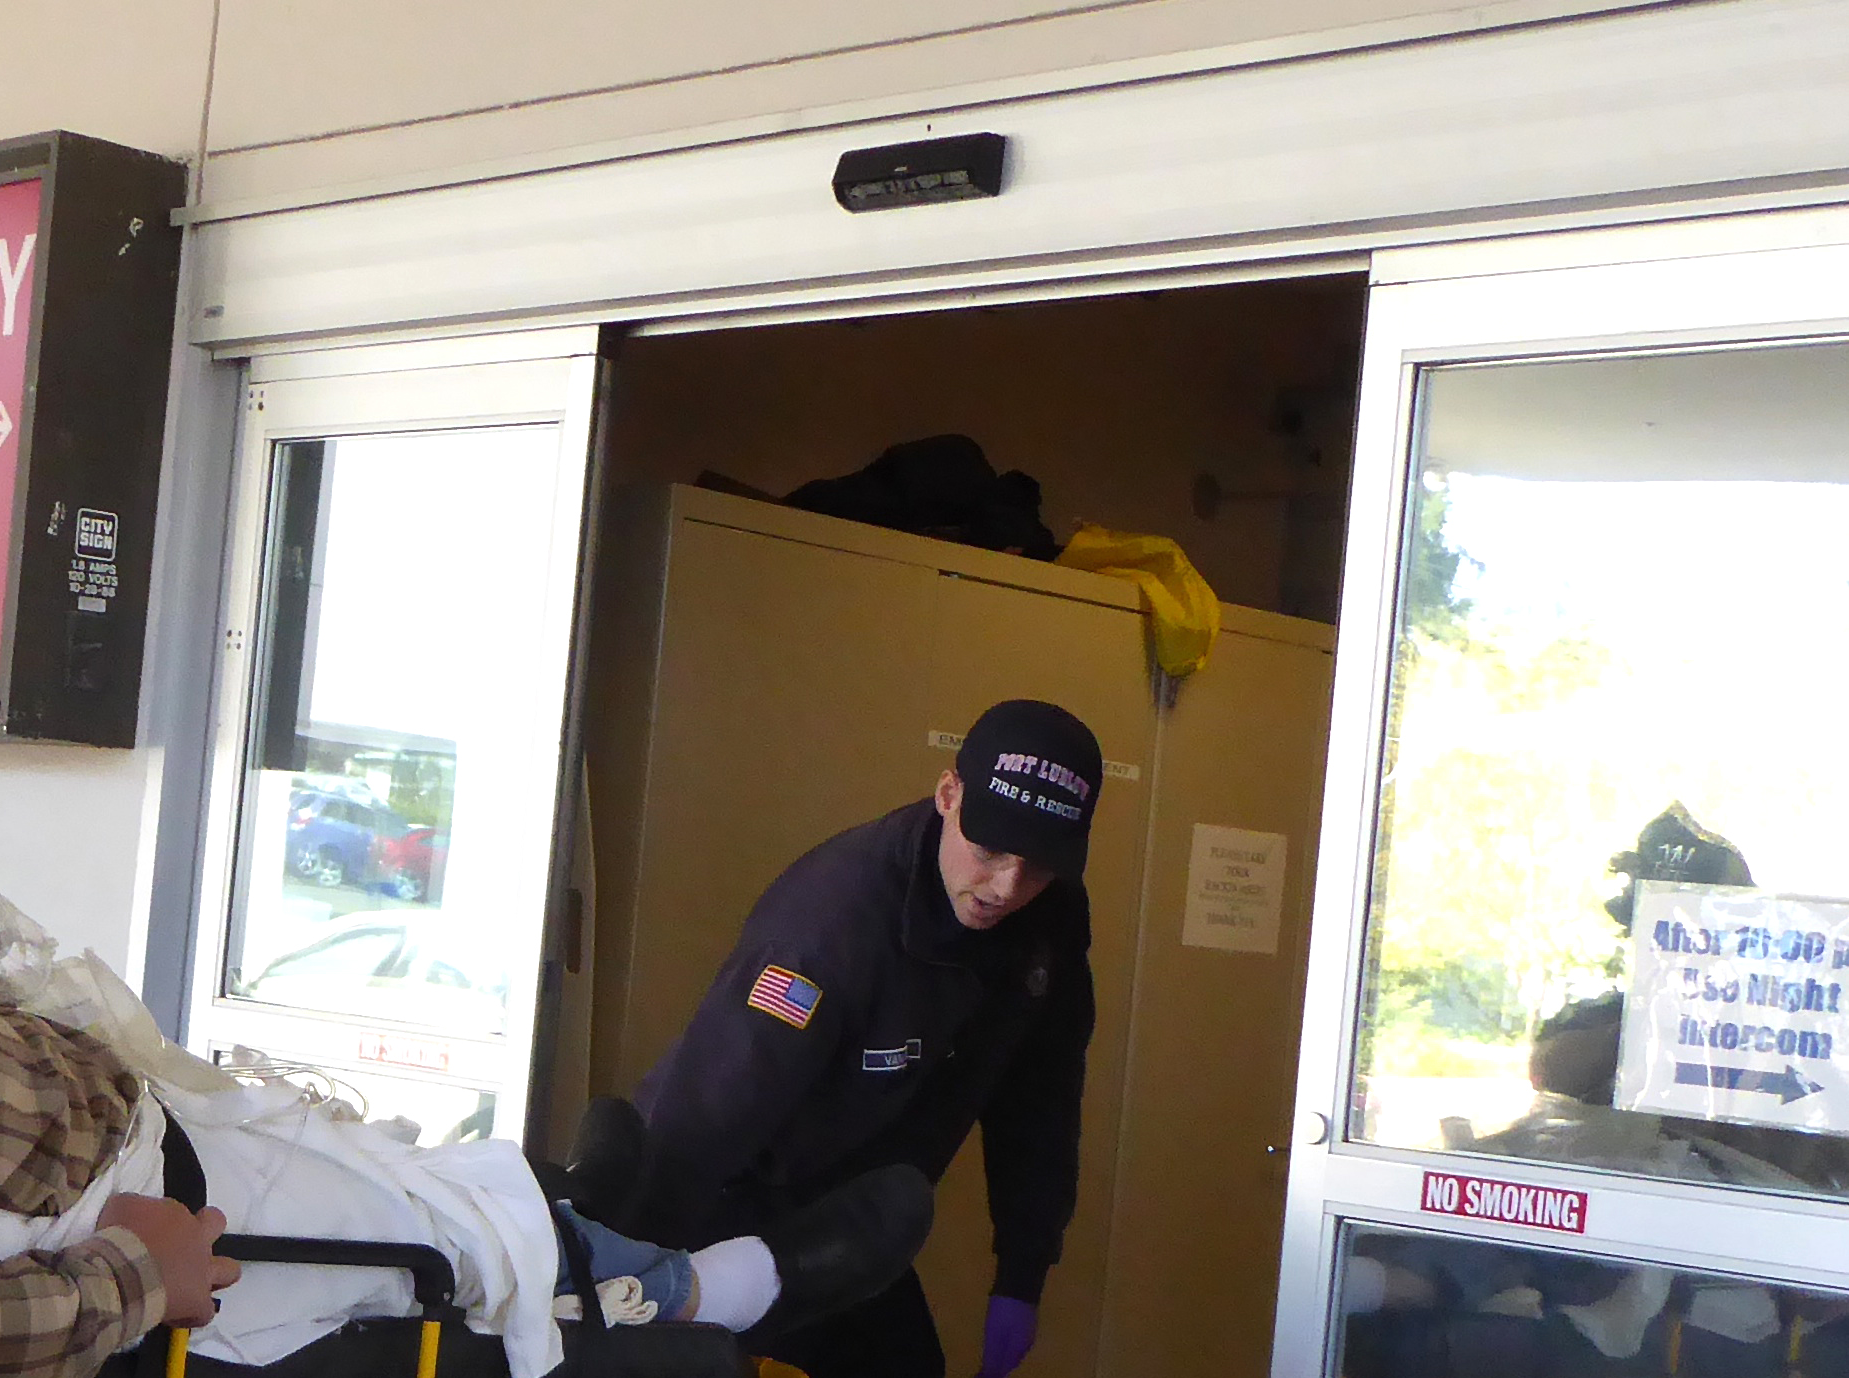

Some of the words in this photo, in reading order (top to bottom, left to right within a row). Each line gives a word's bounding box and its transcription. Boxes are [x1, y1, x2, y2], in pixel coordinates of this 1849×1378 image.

[81, 517, 113, 535] CITY
[80, 533, 112, 549] SIGN
[89, 574, 118, 586] VOLTS
[988, 776, 1019, 799] FIRE
[1020, 790, 1031, 803] &
[1034, 794, 1083, 820] RESCUE
[1746, 973, 1842, 1013] Night
[1425, 1175, 1459, 1212] NO
[1464, 1180, 1580, 1229] SMOKING
